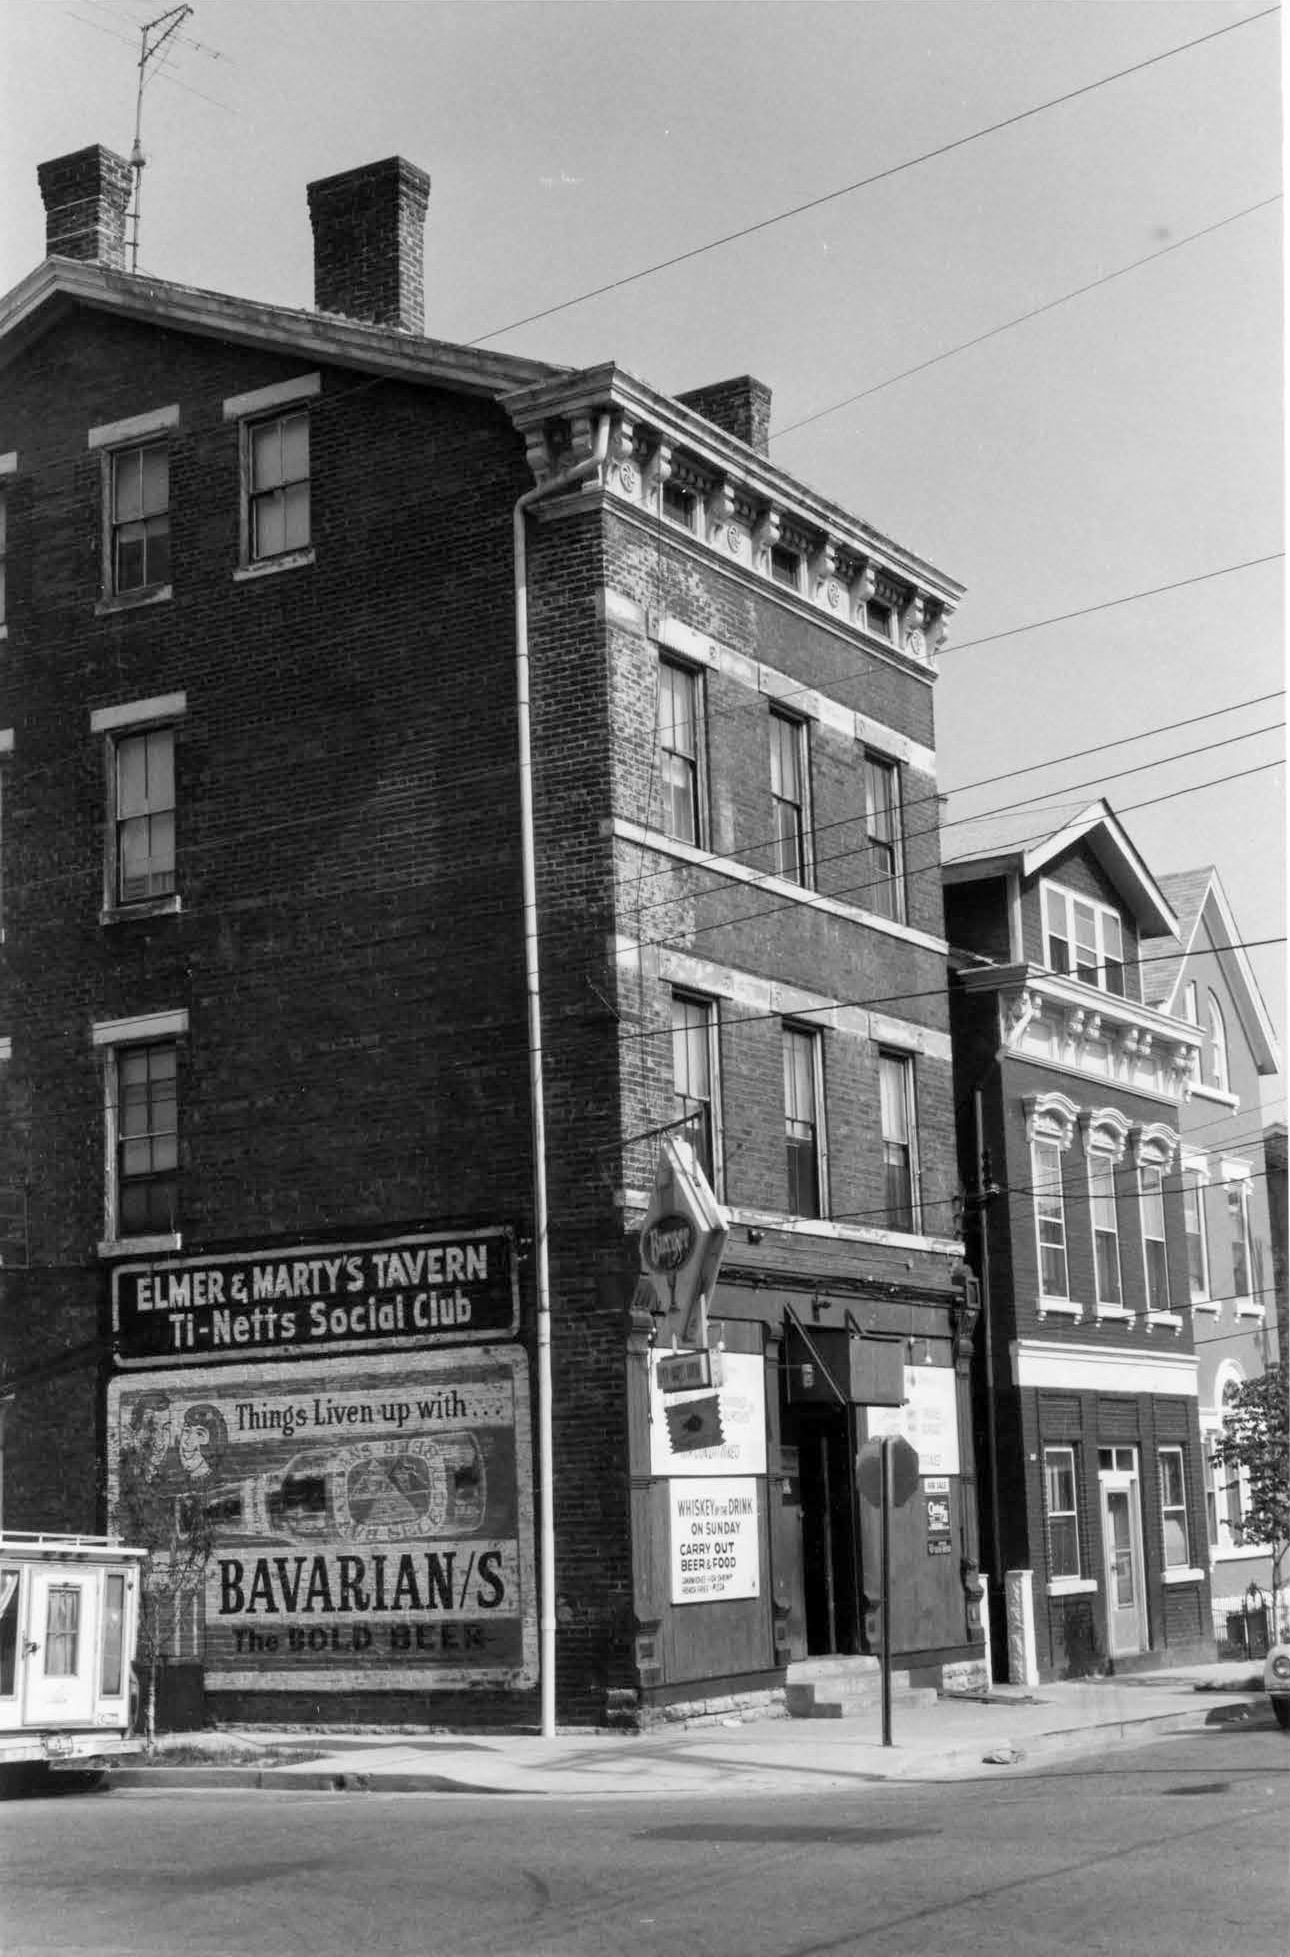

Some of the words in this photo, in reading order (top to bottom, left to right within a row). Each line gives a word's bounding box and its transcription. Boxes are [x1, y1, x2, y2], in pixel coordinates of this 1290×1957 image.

[136, 1271, 226, 1311] ELMER
[230, 1272, 249, 1304] &
[252, 1254, 365, 1300] MARTY'S
[371, 1244, 488, 1289] TAVERN
[168, 1306, 296, 1347] Ti-Netts
[309, 1293, 405, 1336] Social
[413, 1287, 472, 1327] Club
[235, 1402, 308, 1436] Things
[313, 1398, 375, 1426] Liven
[381, 1402, 412, 1428] up
[677, 1499, 715, 1517] WHISKEY
[728, 1497, 753, 1515] DRINK
[691, 1522, 703, 1535] ON
[705, 1520, 741, 1535] SUNDAY
[679, 1542, 711, 1556] CARRY
[714, 1541, 735, 1555] OUT
[681, 1558, 705, 1572] BEER
[712, 1556, 736, 1569] FOOD
